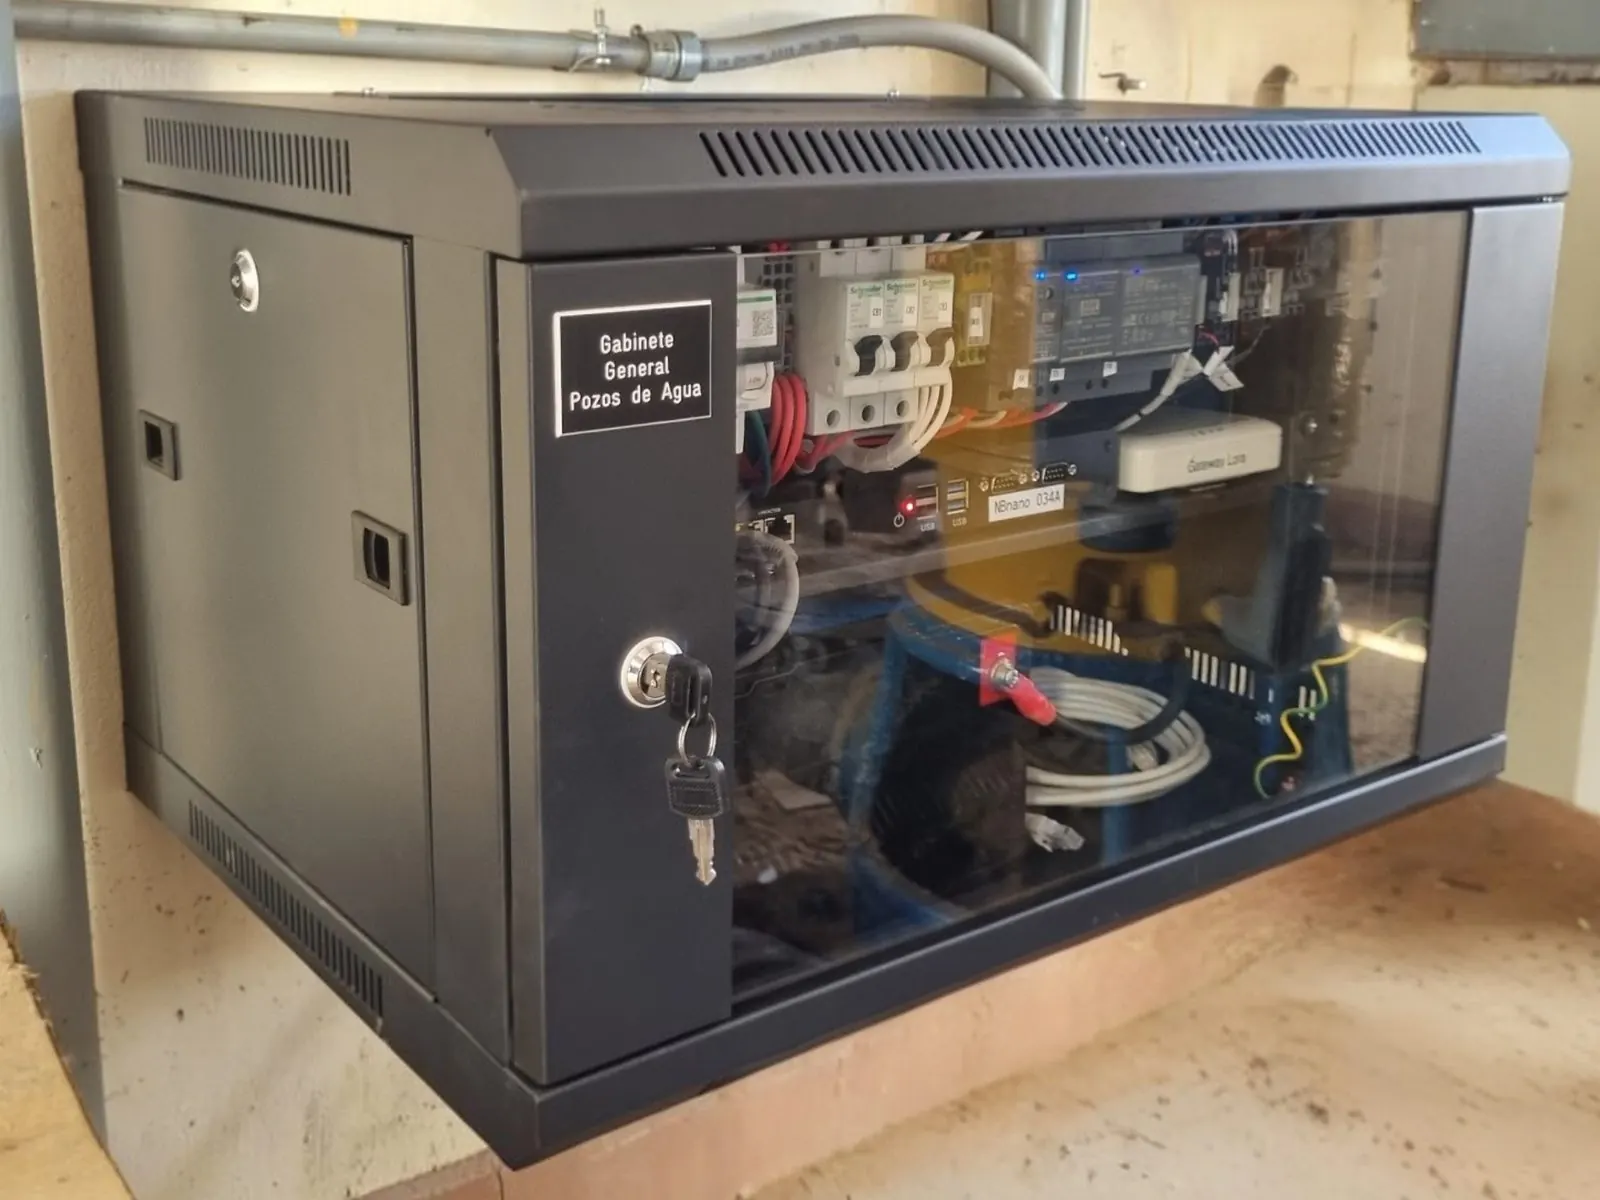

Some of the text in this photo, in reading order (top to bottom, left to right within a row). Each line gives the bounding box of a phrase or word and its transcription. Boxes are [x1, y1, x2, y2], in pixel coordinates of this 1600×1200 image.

[600, 331, 674, 354] Gabinete
[604, 356, 670, 380] General
[569, 381, 702, 411] Pozos de Agua
[994, 488, 1062, 514] NBnano 034A
[920, 522, 935, 532] USB
[952, 517, 967, 527] USB
